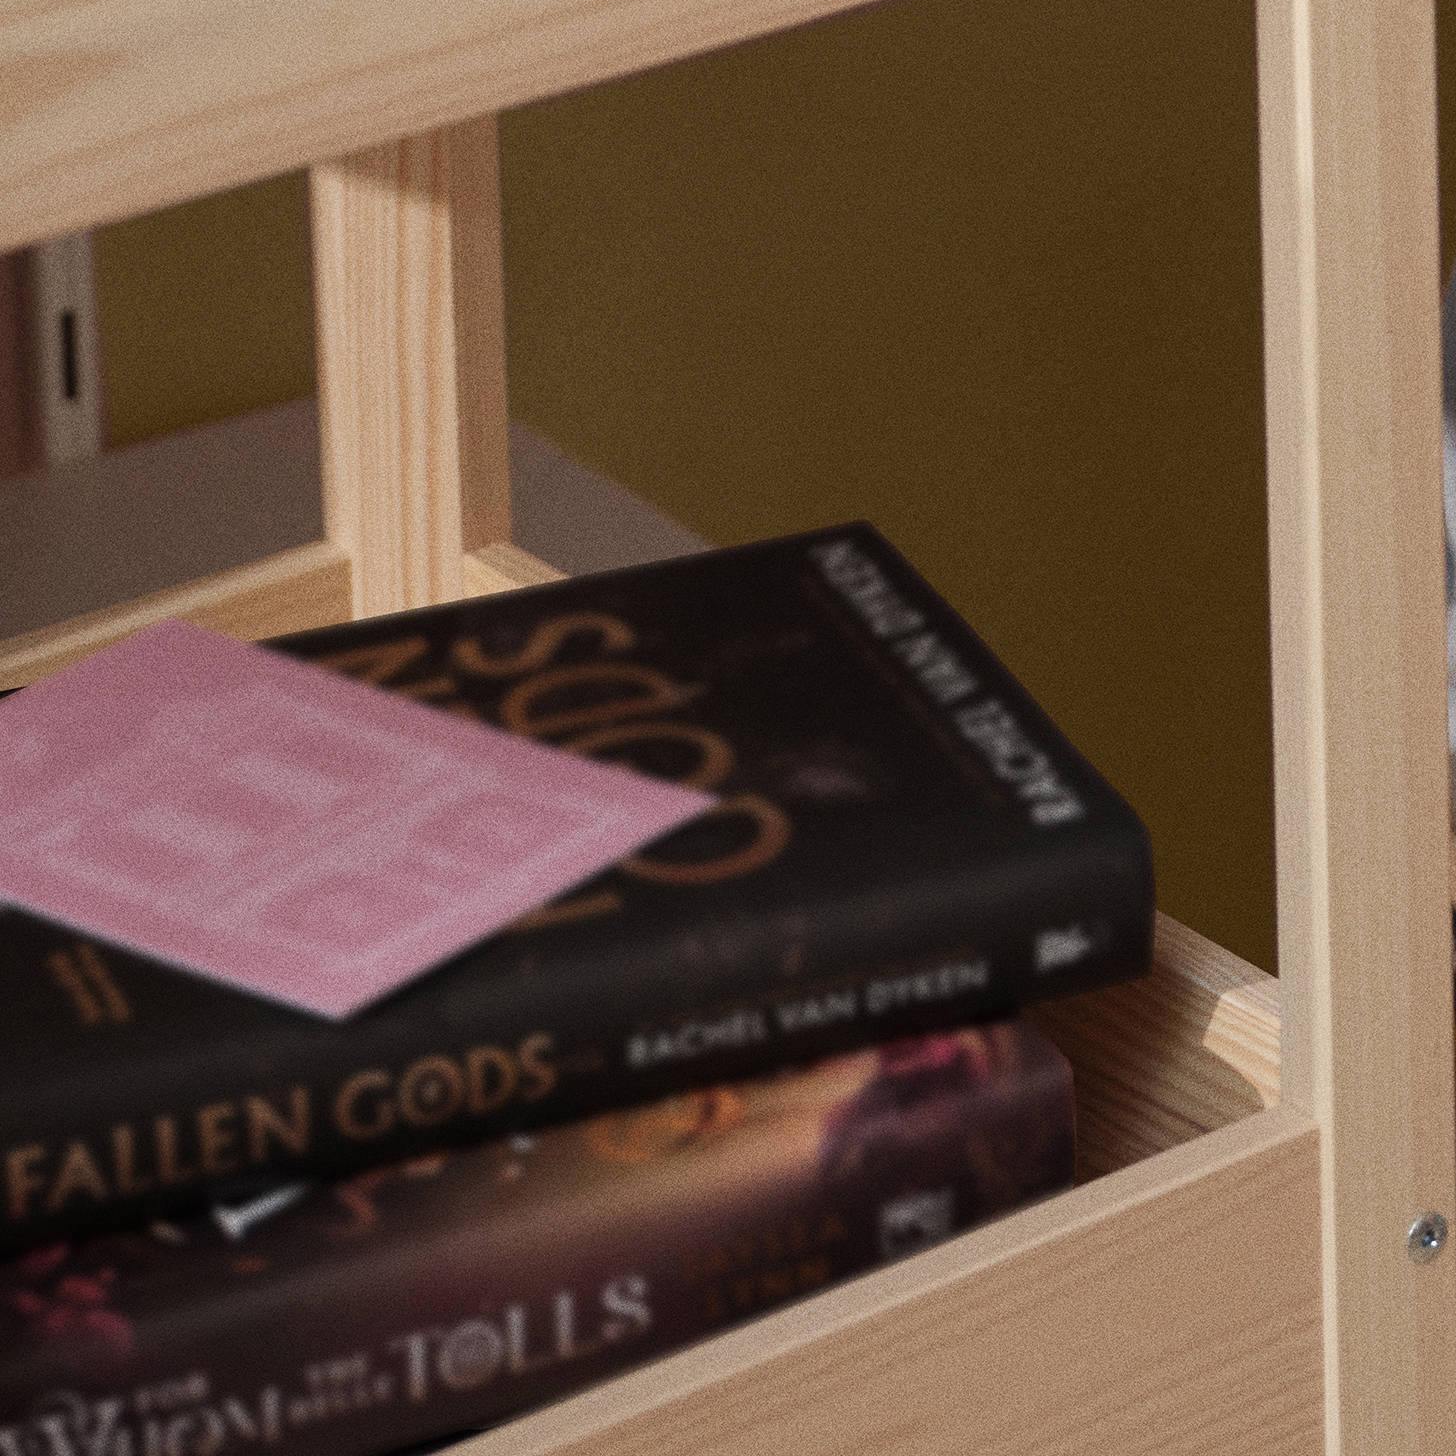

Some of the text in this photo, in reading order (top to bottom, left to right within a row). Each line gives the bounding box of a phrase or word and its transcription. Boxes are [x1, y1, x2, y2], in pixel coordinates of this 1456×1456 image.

[5, 1082, 312, 1222] FALLEN
[333, 1028, 559, 1140] GODS
[627, 1010, 767, 1070] RACHEL
[776, 992, 857, 1032] VAN
[866, 959, 990, 1015] DYKEN
[390, 1273, 654, 1404] TOLLS
